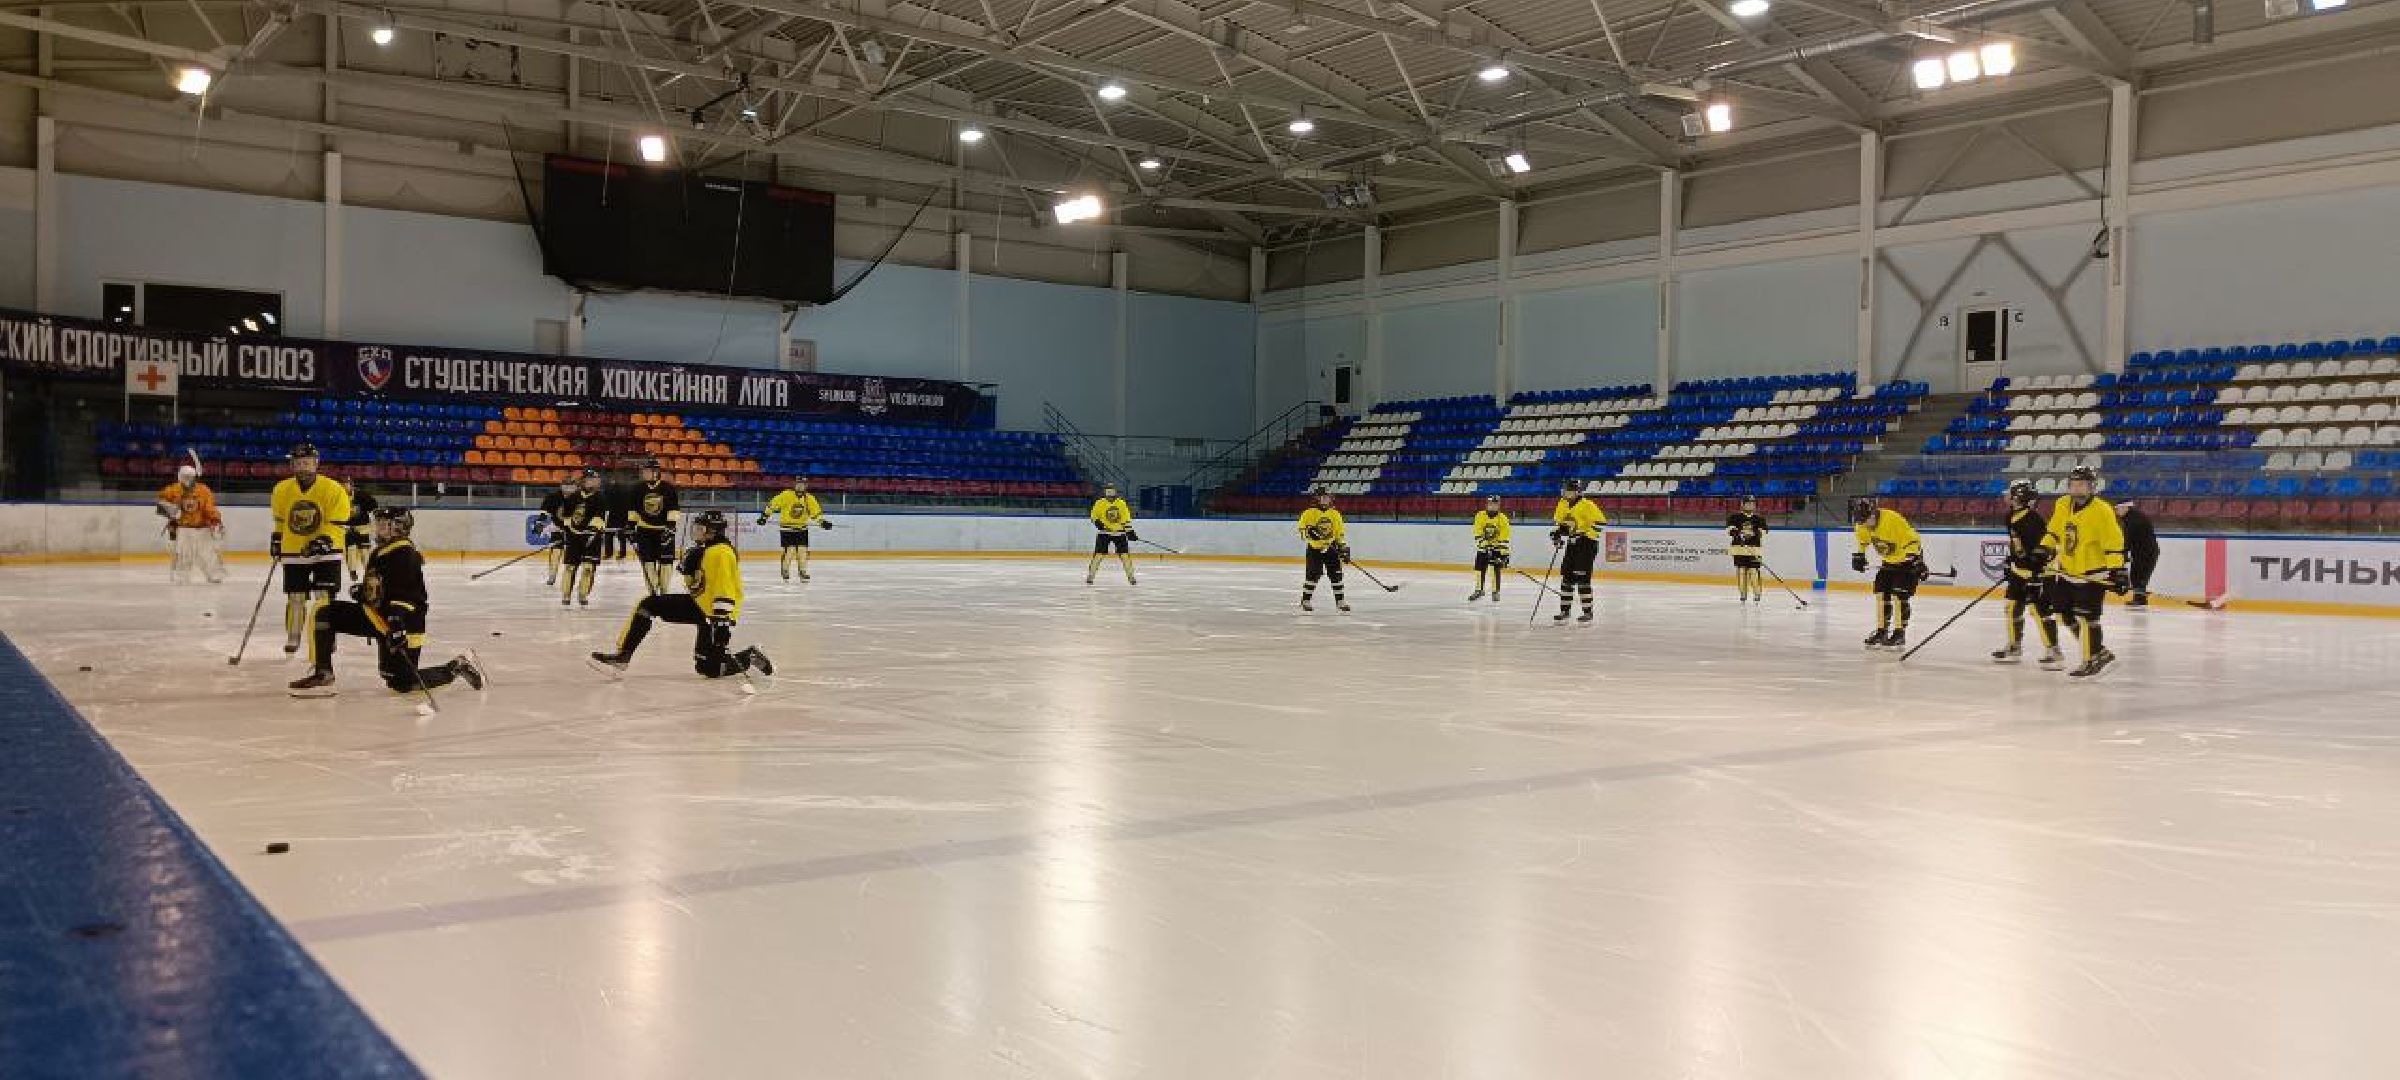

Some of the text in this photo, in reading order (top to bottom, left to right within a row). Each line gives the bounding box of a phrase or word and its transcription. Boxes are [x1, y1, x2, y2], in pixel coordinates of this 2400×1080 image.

[61, 328, 229, 376] СПОРТИВНЫЙ
[238, 345, 316, 382] СОЮЗ
[405, 356, 788, 407] СТУДЕНЧЕСКАЯ ХОККЕЙНАЯ ЛИГА
[2250, 555, 2400, 586] ТИНЬК
